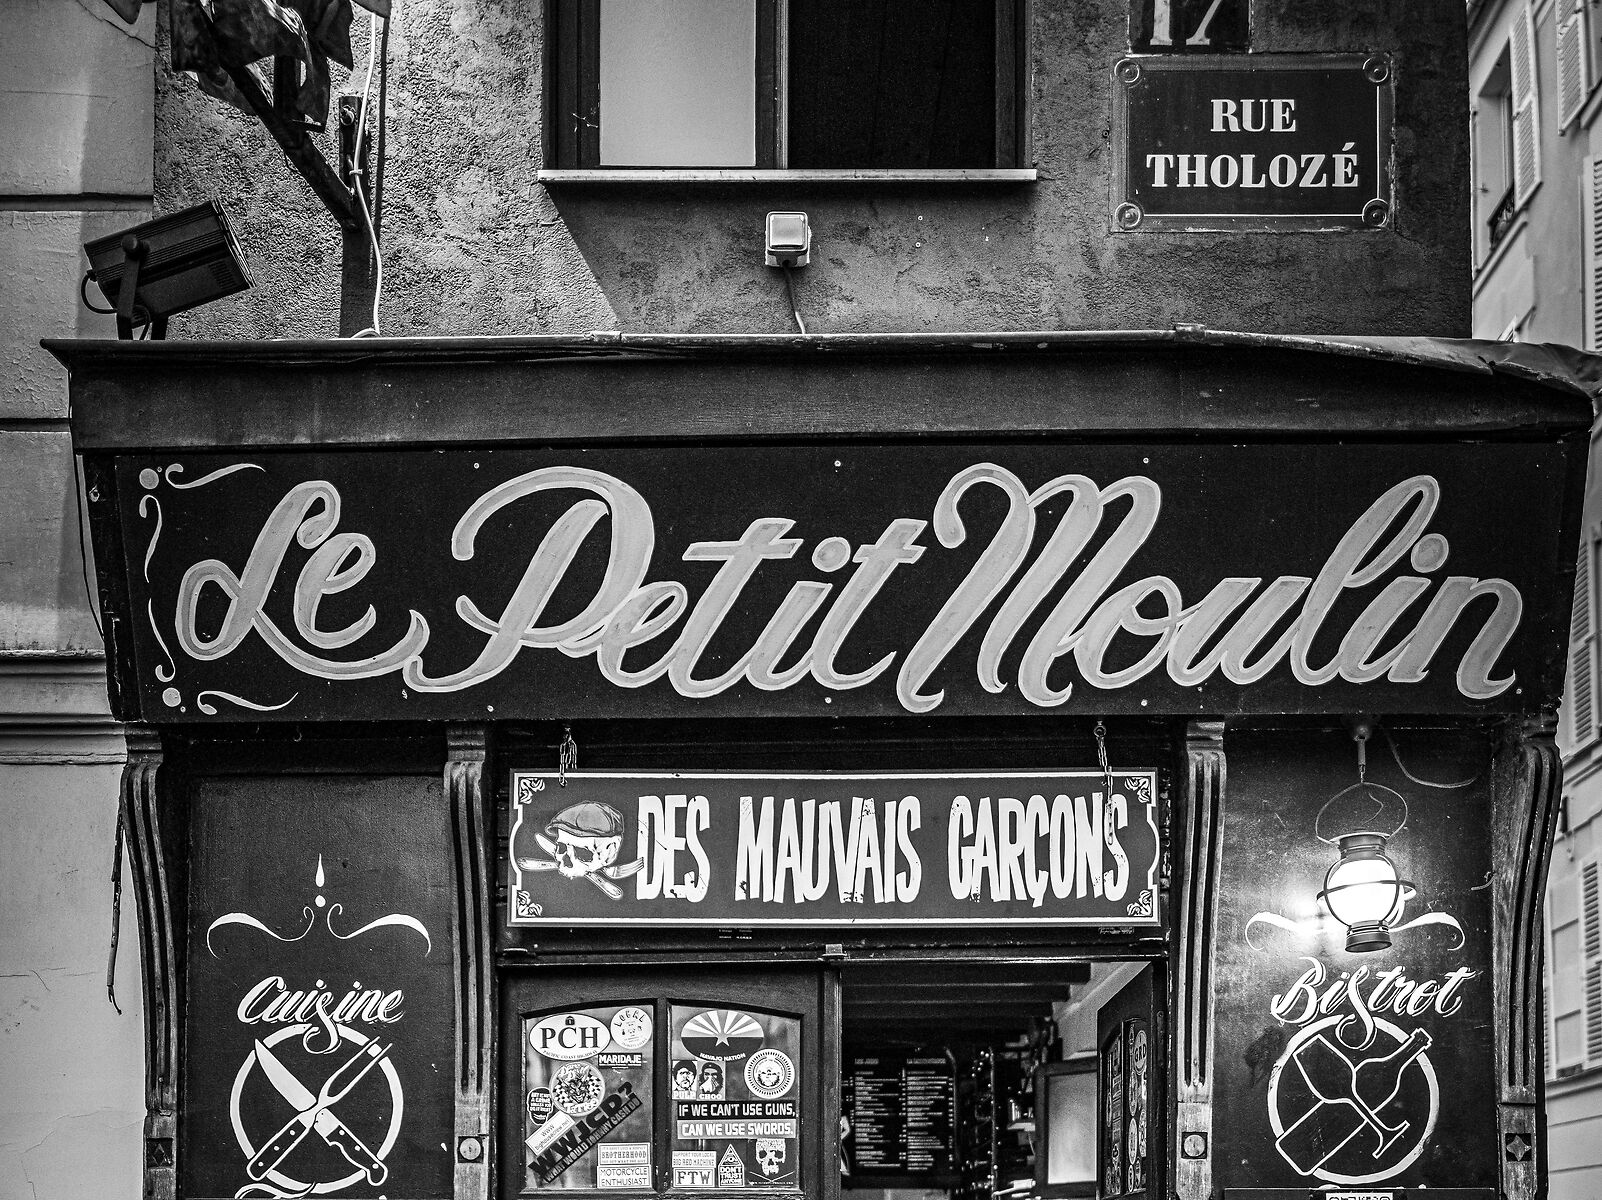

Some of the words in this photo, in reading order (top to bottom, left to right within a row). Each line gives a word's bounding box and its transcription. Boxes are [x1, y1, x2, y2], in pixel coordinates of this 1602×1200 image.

[1210, 99, 1297, 132] RUE
[1146, 142, 1360, 189] THOLOZÉ
[175, 480, 430, 681] Le
[403, 466, 927, 698] Petit
[898, 462, 1523, 713] Moulin
[636, 795, 711, 902] DES
[735, 796, 921, 903] MAUVAIS
[948, 792, 1130, 907] GARÇONS
[1270, 957, 1477, 1050] Bistrot
[237, 976, 406, 1054] Cuisine
[540, 1026, 601, 1049] PCH
[599, 1054, 642, 1064] MARIDAJE
[699, 1052, 723, 1062] NAVAJO
[724, 1052, 746, 1062] NATION
[678, 1104, 689, 1116] IF
[691, 1104, 708, 1116] WE
[710, 1103, 740, 1116] CAN'T
[742, 1103, 763, 1116] USE
[765, 1102, 797, 1118] GUNS,
[564, 1142, 589, 1164] WOULD
[587, 1120, 613, 1146] JOHNNY
[610, 1105, 632, 1125] CASH
[682, 1123, 703, 1137] CAN
[705, 1123, 723, 1136] WE
[725, 1123, 746, 1136] USE
[747, 1122, 794, 1136] SWORDS.
[600, 1167, 648, 1176] MOTORCYCLE
[676, 1170, 711, 1185] FTW
[720, 1166, 743, 1174] DON'T
[601, 1177, 648, 1187] ENTHUSIAST
